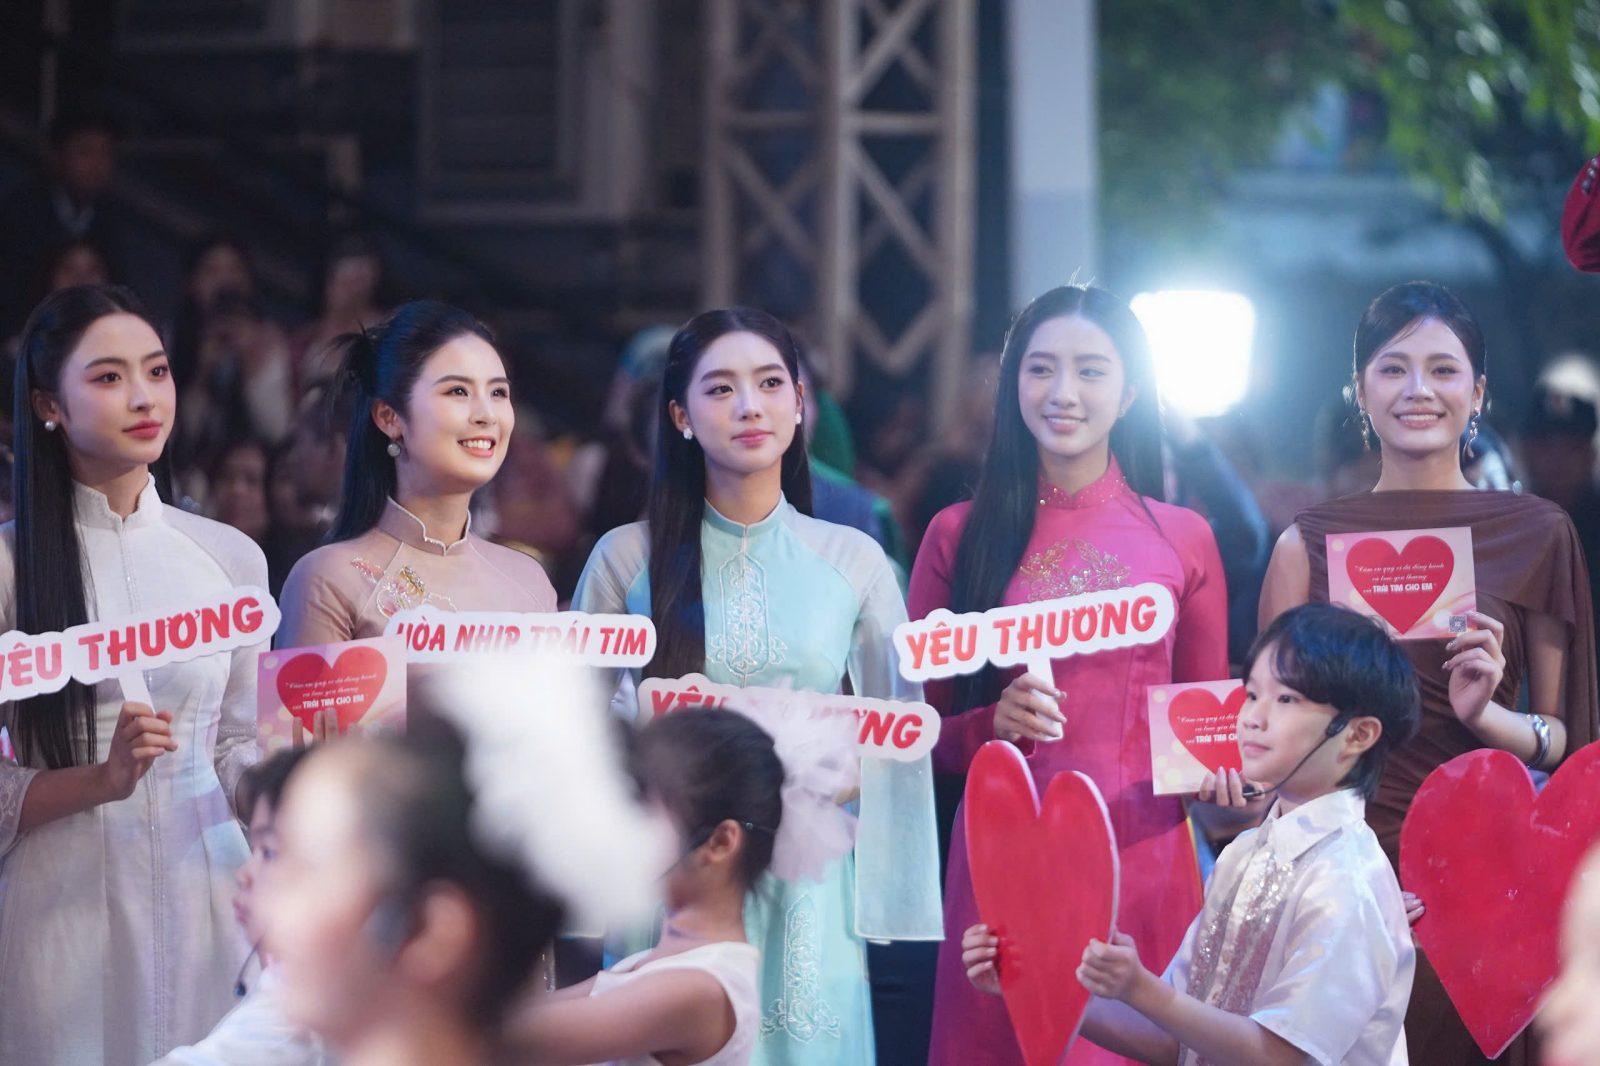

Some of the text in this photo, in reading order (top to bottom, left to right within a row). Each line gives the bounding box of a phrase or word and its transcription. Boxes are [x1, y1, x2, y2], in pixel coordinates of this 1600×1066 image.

[78, 597, 264, 670] THƯƠNG
[600, 627, 648, 656] TIM
[906, 596, 1157, 670] YÊU THƯƠNG
